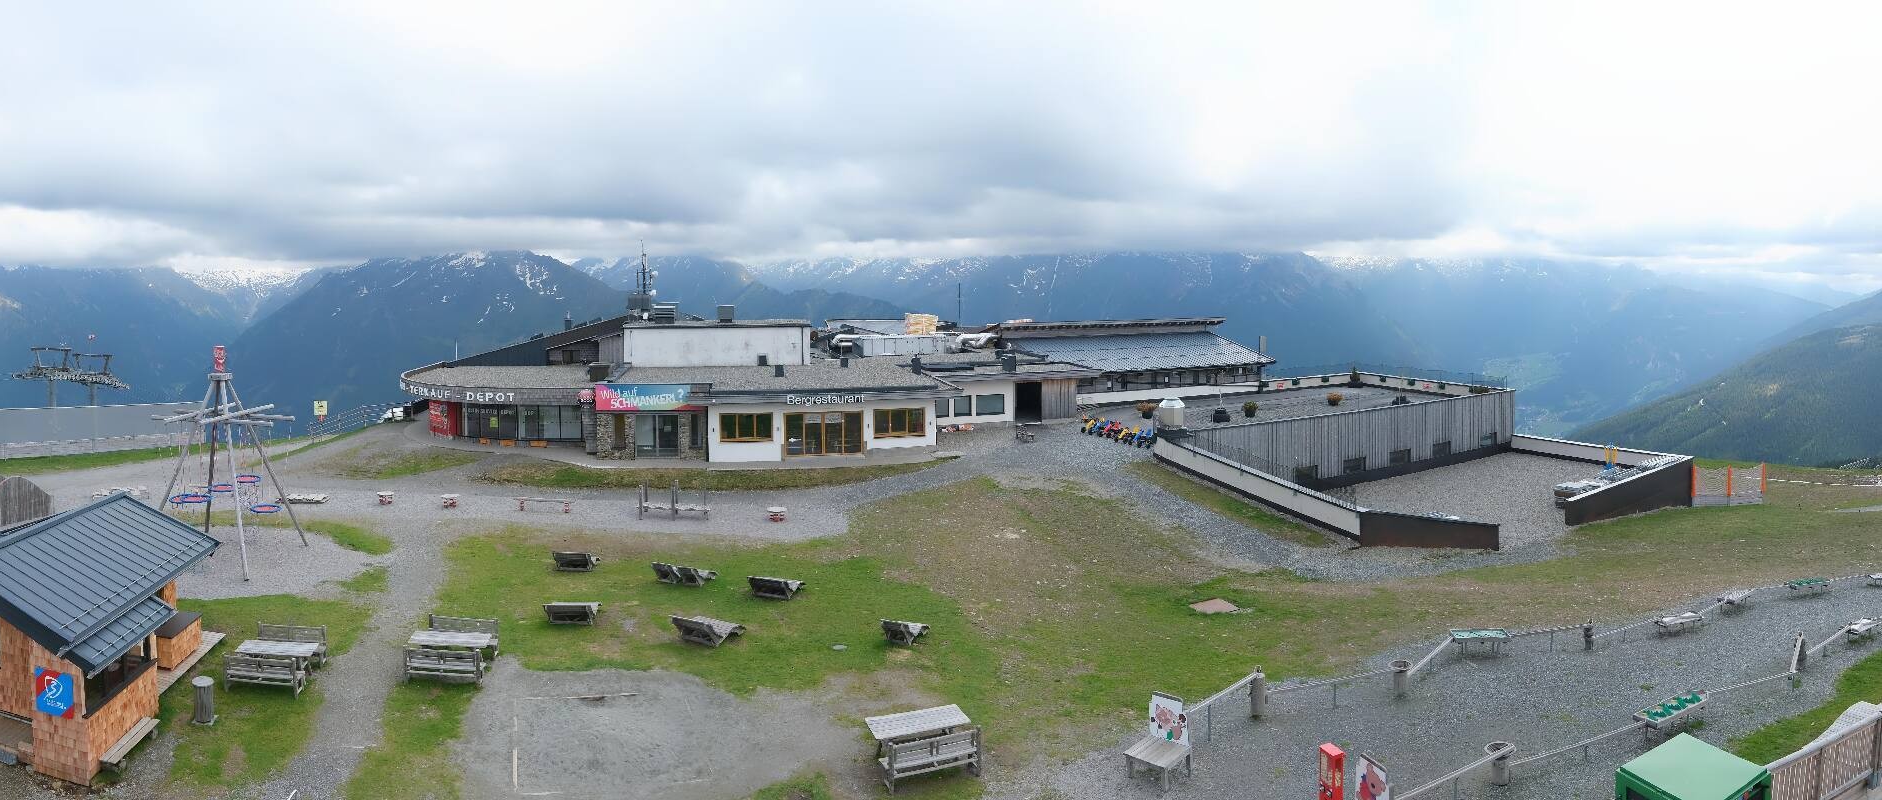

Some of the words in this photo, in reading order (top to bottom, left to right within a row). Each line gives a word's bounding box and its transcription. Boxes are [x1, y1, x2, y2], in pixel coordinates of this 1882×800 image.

[466, 392, 515, 402] DEPOT
[600, 388, 620, 400] Wild
[622, 387, 638, 397] auf
[787, 394, 865, 407] Bergrestaurant
